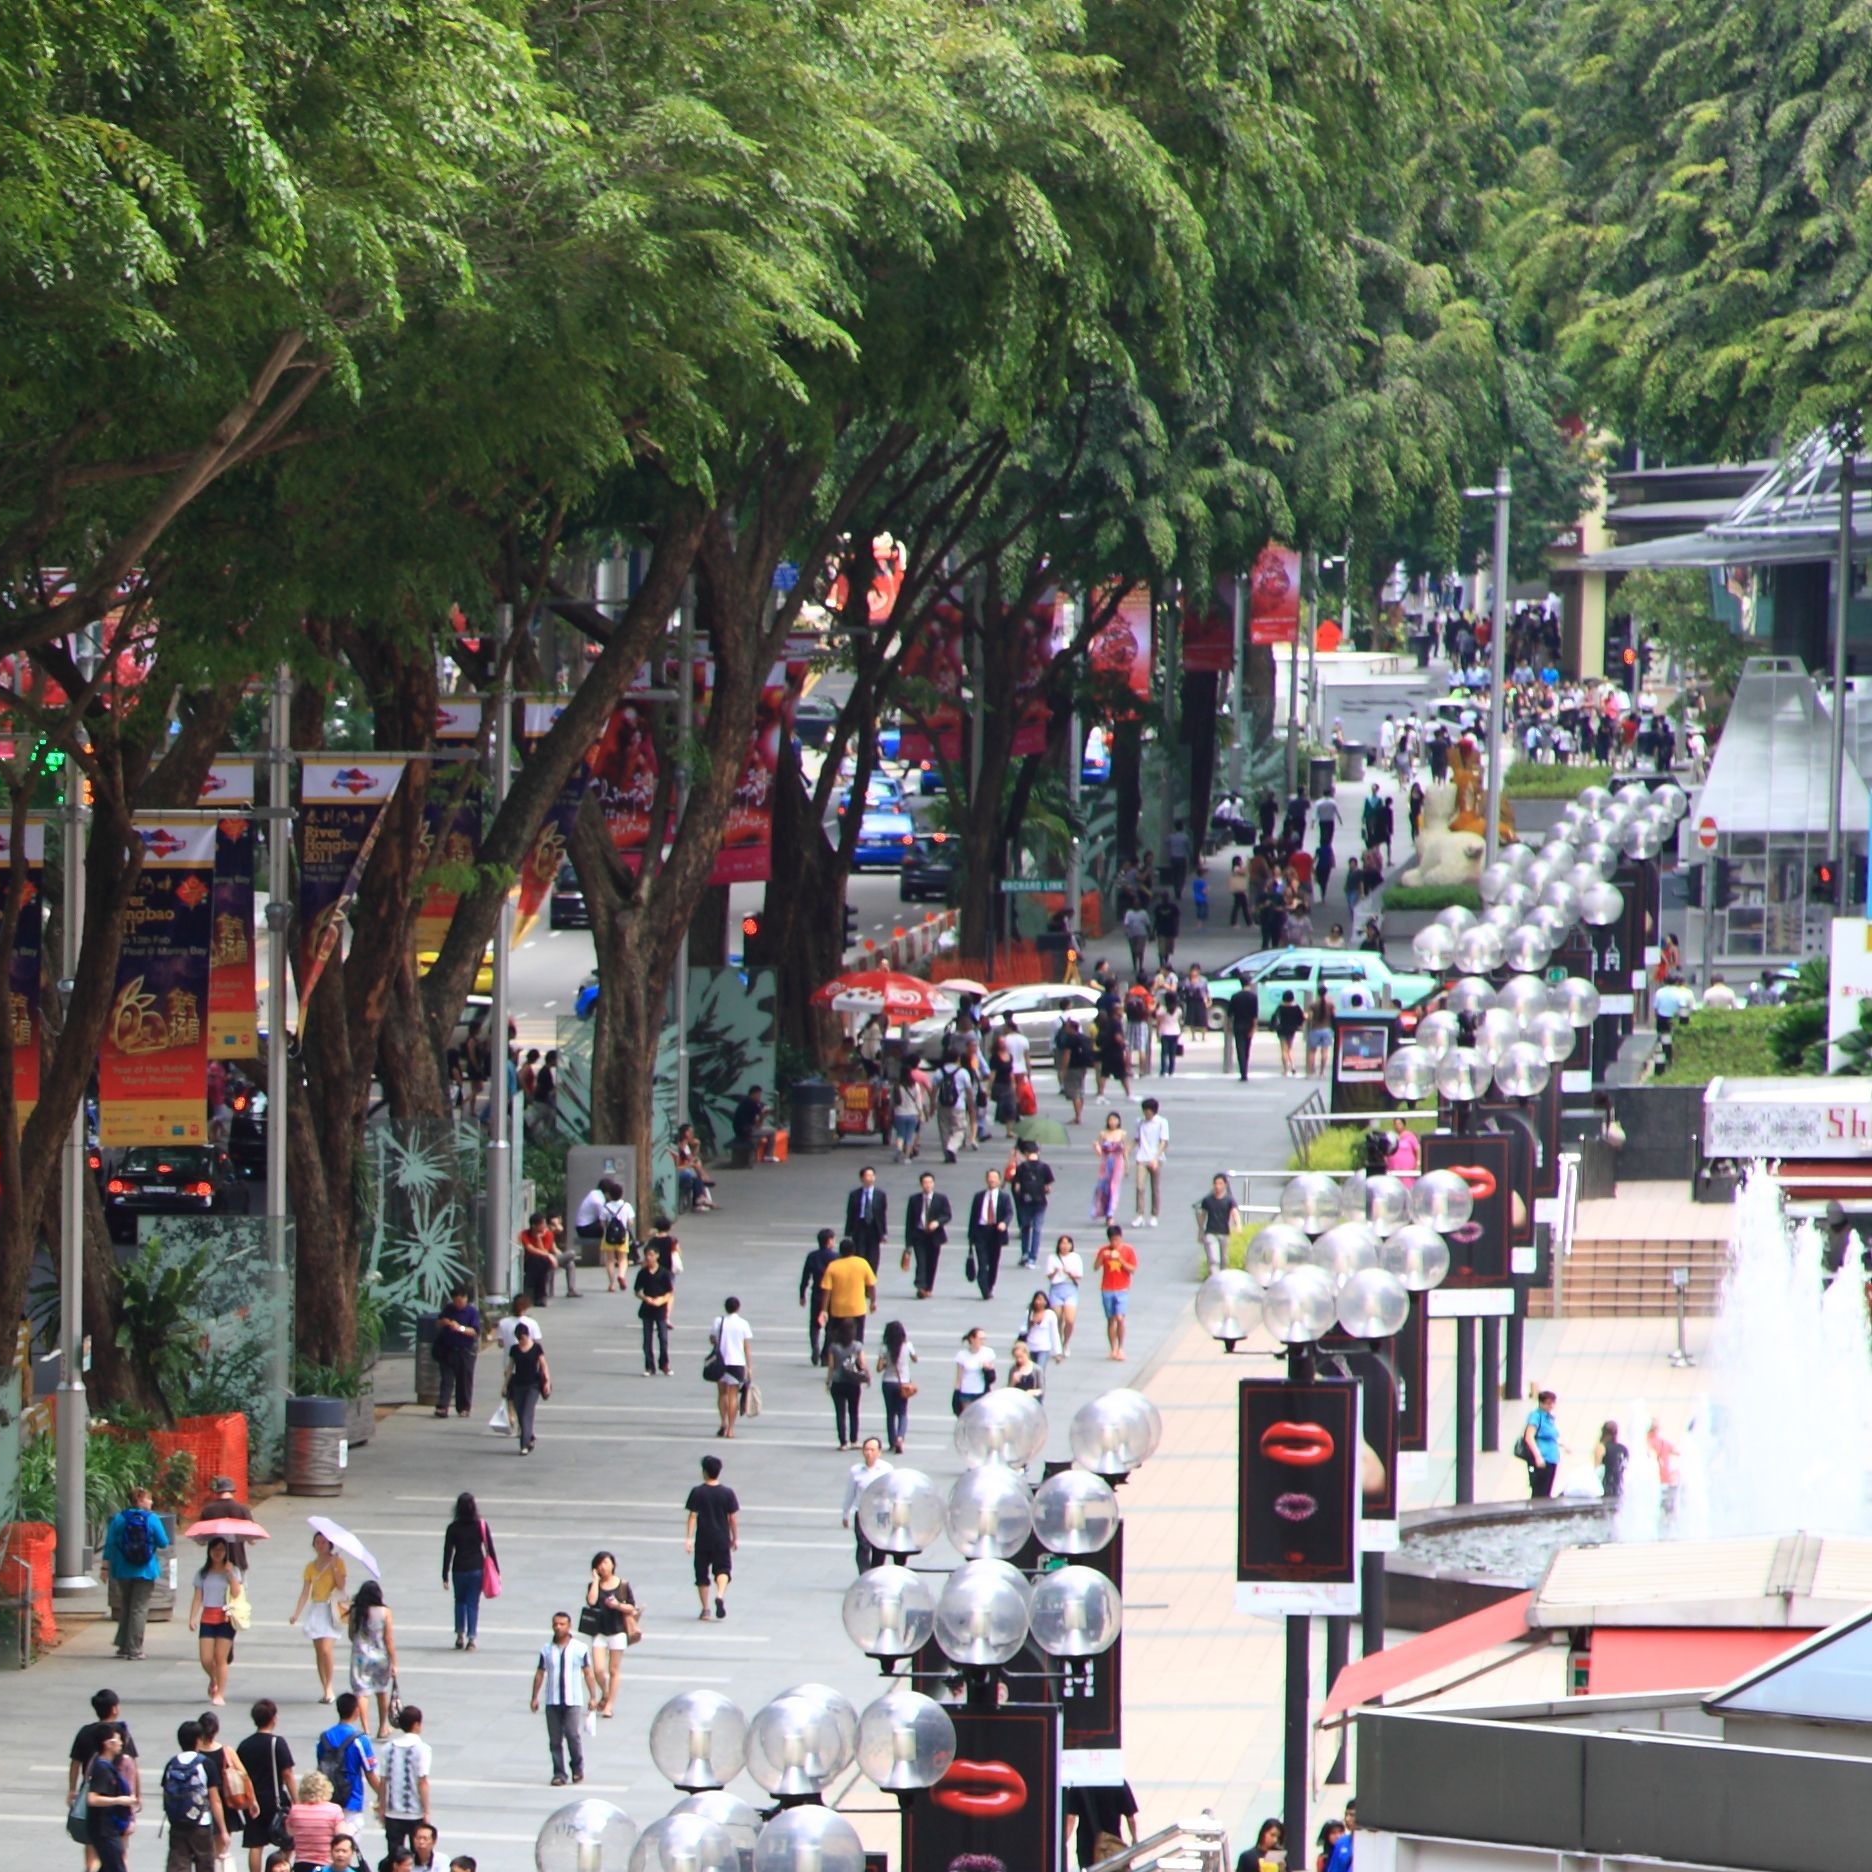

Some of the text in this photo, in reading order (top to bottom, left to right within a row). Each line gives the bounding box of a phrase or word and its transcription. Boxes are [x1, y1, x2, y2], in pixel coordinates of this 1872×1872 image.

[305, 826, 342, 839] River
[1043, 881, 1064, 892] LINK
[112, 1064, 133, 1074] Year
[135, 1064, 145, 1074] of
[147, 1065, 160, 1074] the
[122, 1076, 147, 1087] Many
